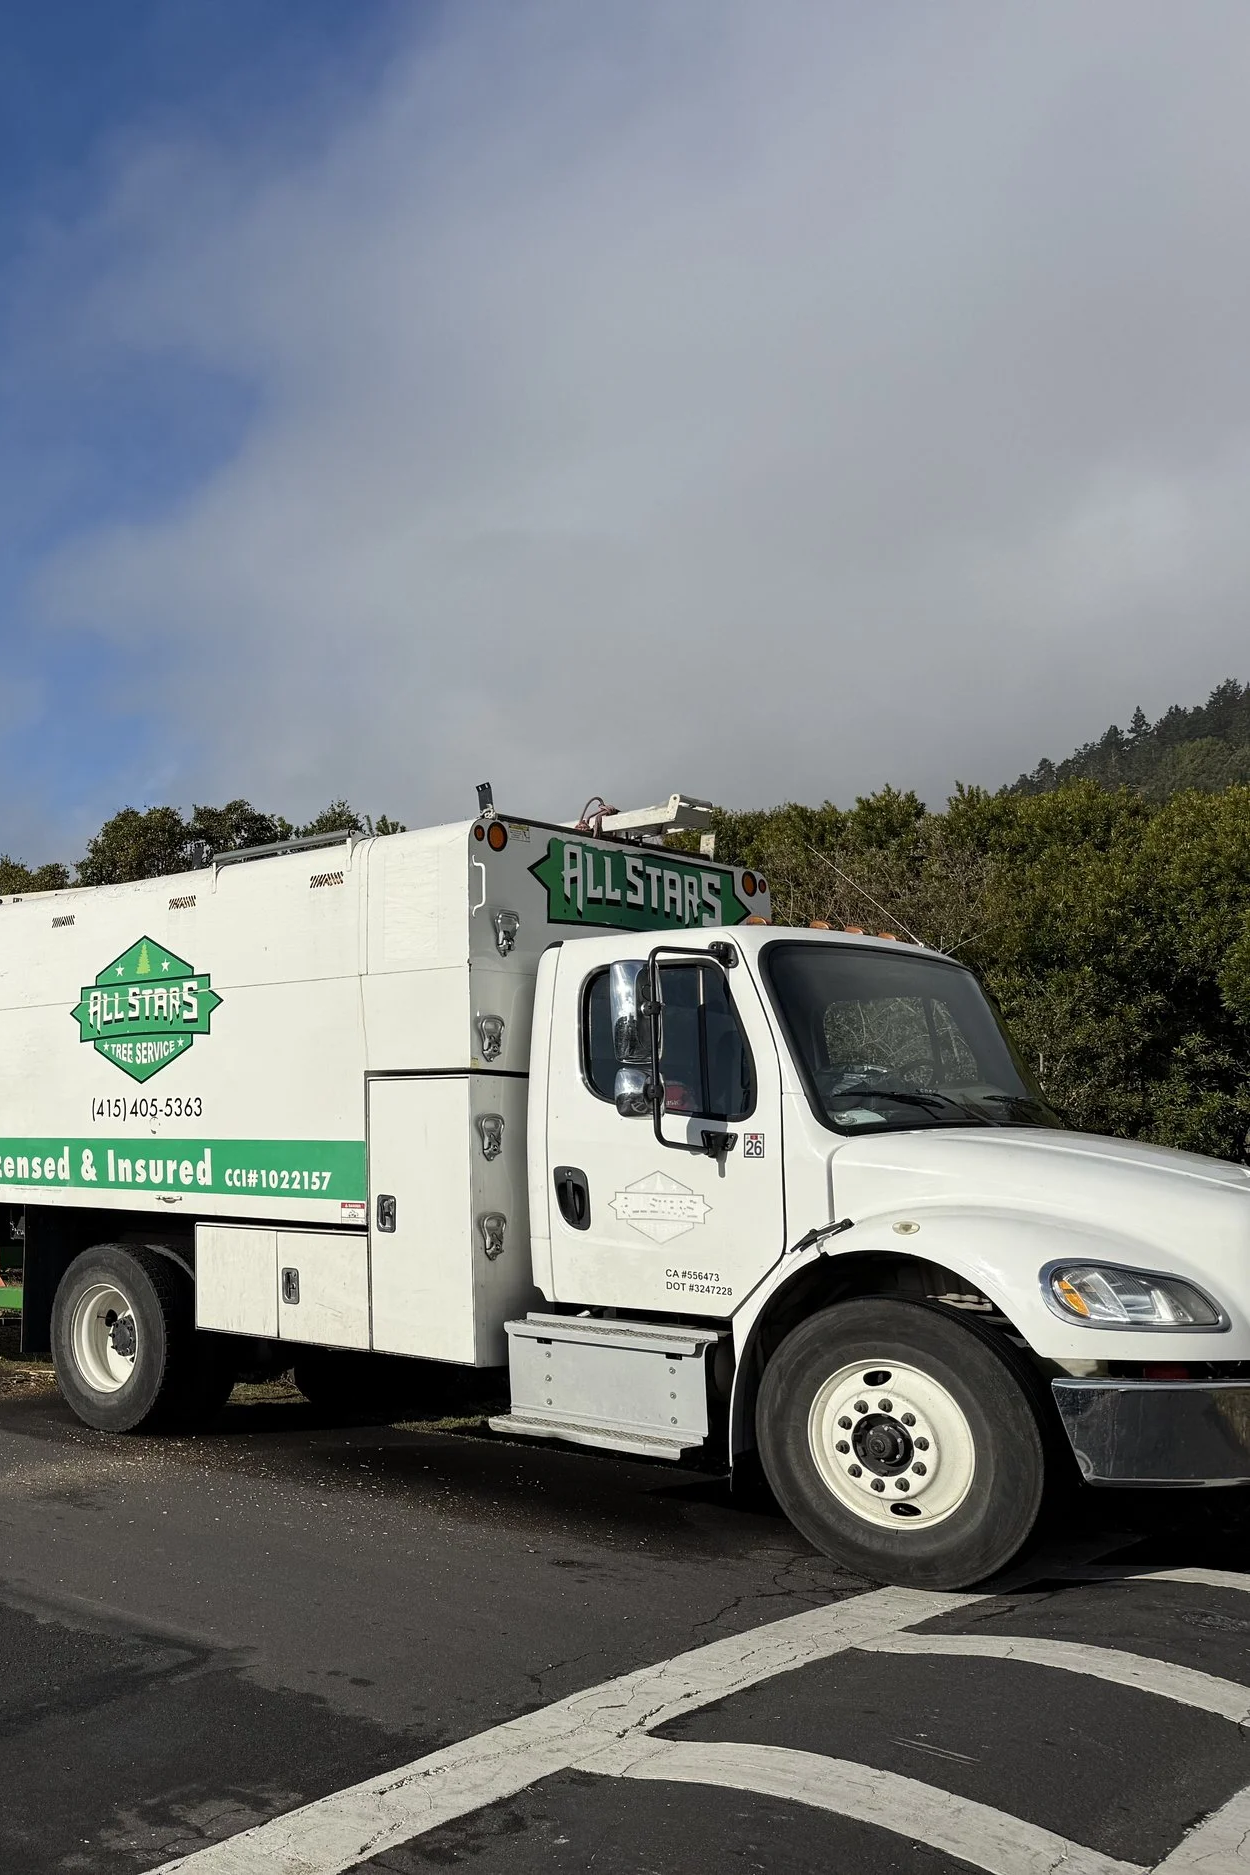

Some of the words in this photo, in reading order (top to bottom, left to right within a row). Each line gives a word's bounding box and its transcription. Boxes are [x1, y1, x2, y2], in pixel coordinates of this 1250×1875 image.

[110, 1042, 134, 1064] TREE
[136, 1040, 176, 1065] SERVICE
[92, 1097, 127, 1121] (415)
[130, 1097, 203, 1117] 405-5363
[746, 1139, 762, 1156] 26
[80, 1148, 98, 1182] &
[107, 1147, 213, 1186] Insured
[224, 1168, 332, 1191] CCI#1022157
[665, 1268, 680, 1279] CA
[681, 1270, 720, 1282] #556473
[666, 1281, 687, 1292] DOT
[688, 1283, 733, 1296] #3247228
